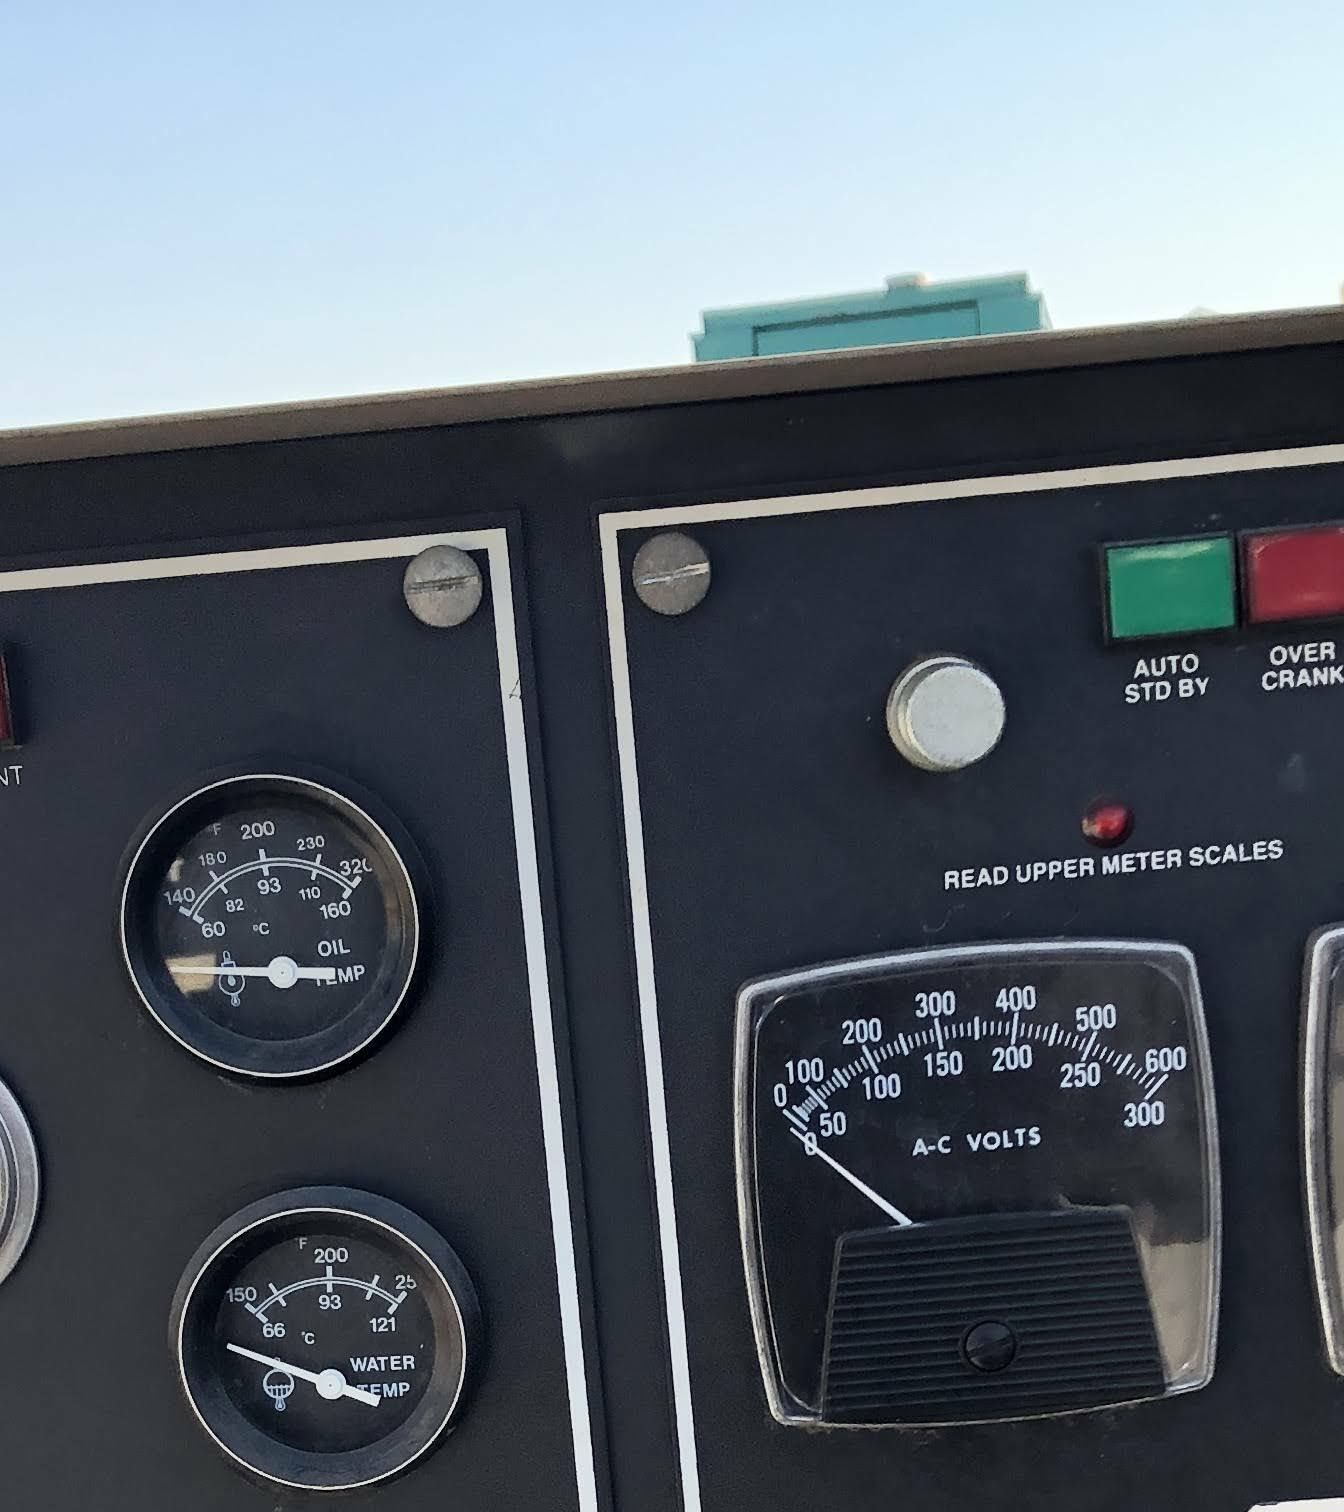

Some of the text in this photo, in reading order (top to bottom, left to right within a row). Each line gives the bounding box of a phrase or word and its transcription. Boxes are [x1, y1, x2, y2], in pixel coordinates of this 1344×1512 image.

[1269, 641, 1335, 666] OVER
[1134, 654, 1199, 679] AUTO
[1261, 664, 1344, 691] CRANK
[1125, 678, 1210, 704] STD BY
[241, 821, 275, 840] 200
[297, 835, 325, 850] 230
[198, 852, 226, 867] 180
[944, 839, 1283, 890] READ UPPER METER SCALES
[164, 887, 195, 905] 140
[257, 879, 281, 894] 93
[299, 887, 321, 901] 110
[226, 899, 244, 912] 82
[320, 901, 350, 919] 160
[202, 921, 225, 937] 60
[318, 939, 350, 957] OIL
[915, 991, 956, 1018] 300
[996, 986, 1037, 1012] 400
[1076, 1005, 1117, 1031] 500
[841, 1018, 883, 1045] 200
[786, 1058, 824, 1083] 100
[924, 1051, 963, 1077] 150
[992, 1045, 1033, 1071] 200
[1145, 1047, 1186, 1073] 600
[861, 1074, 901, 1100] 100
[1060, 1063, 1101, 1089] 250
[774, 1083, 786, 1107] 0
[819, 1111, 847, 1138] 50
[1124, 1101, 1165, 1128] 300
[912, 1127, 1041, 1157] A-C VOLTS
[314, 1248, 348, 1263] 200
[226, 1287, 256, 1302] 150
[319, 1295, 341, 1309] 93
[263, 1323, 286, 1337] 66
[370, 1318, 396, 1332] 121
[350, 1355, 415, 1371] WATER
